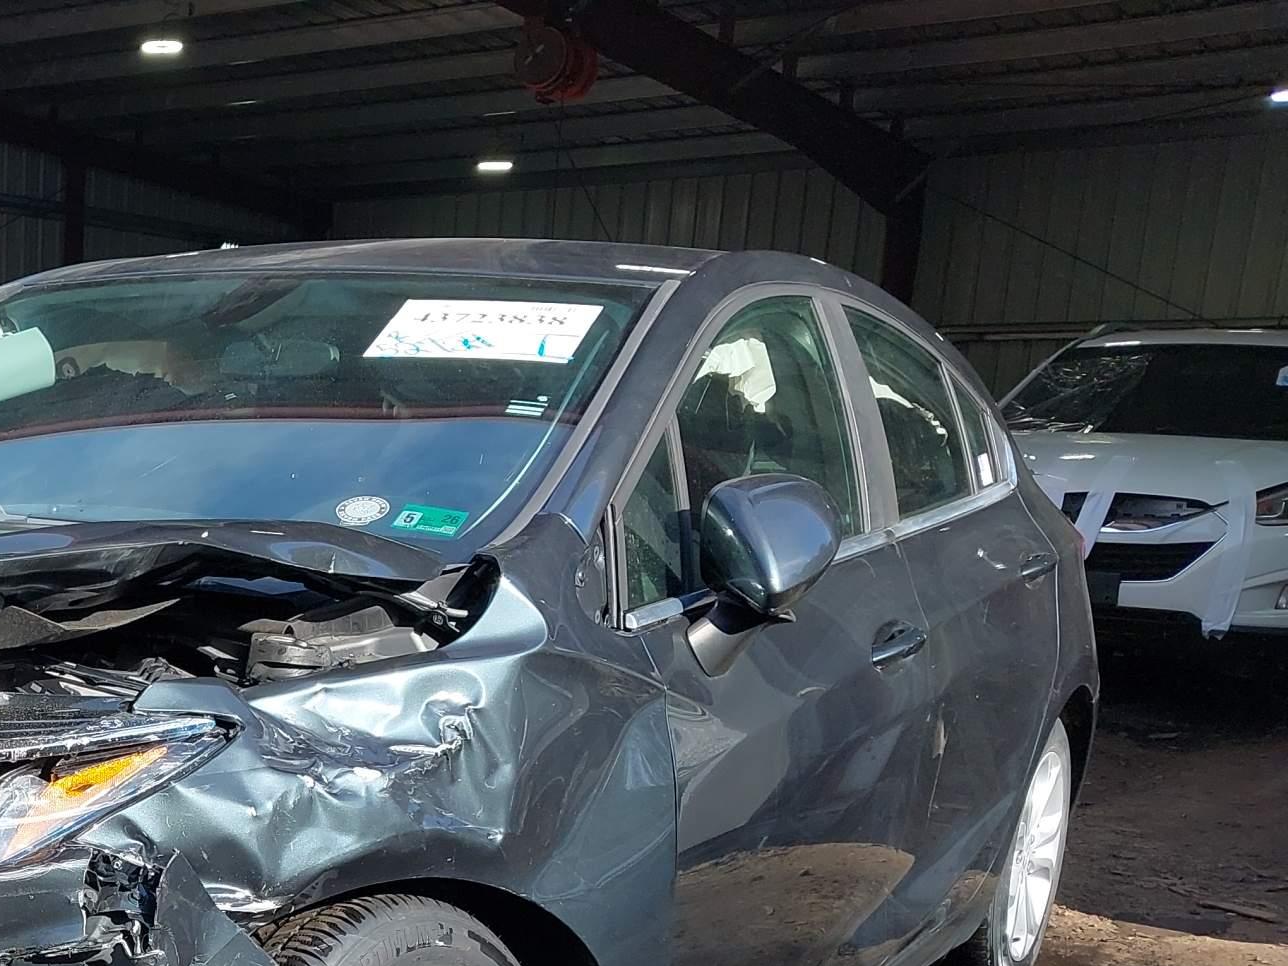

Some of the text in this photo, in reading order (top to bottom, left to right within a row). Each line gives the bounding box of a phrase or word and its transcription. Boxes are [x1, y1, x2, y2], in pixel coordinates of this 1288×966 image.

[414, 311, 567, 326] 43723838
[403, 512, 417, 524] 5
[440, 513, 462, 525] 26
